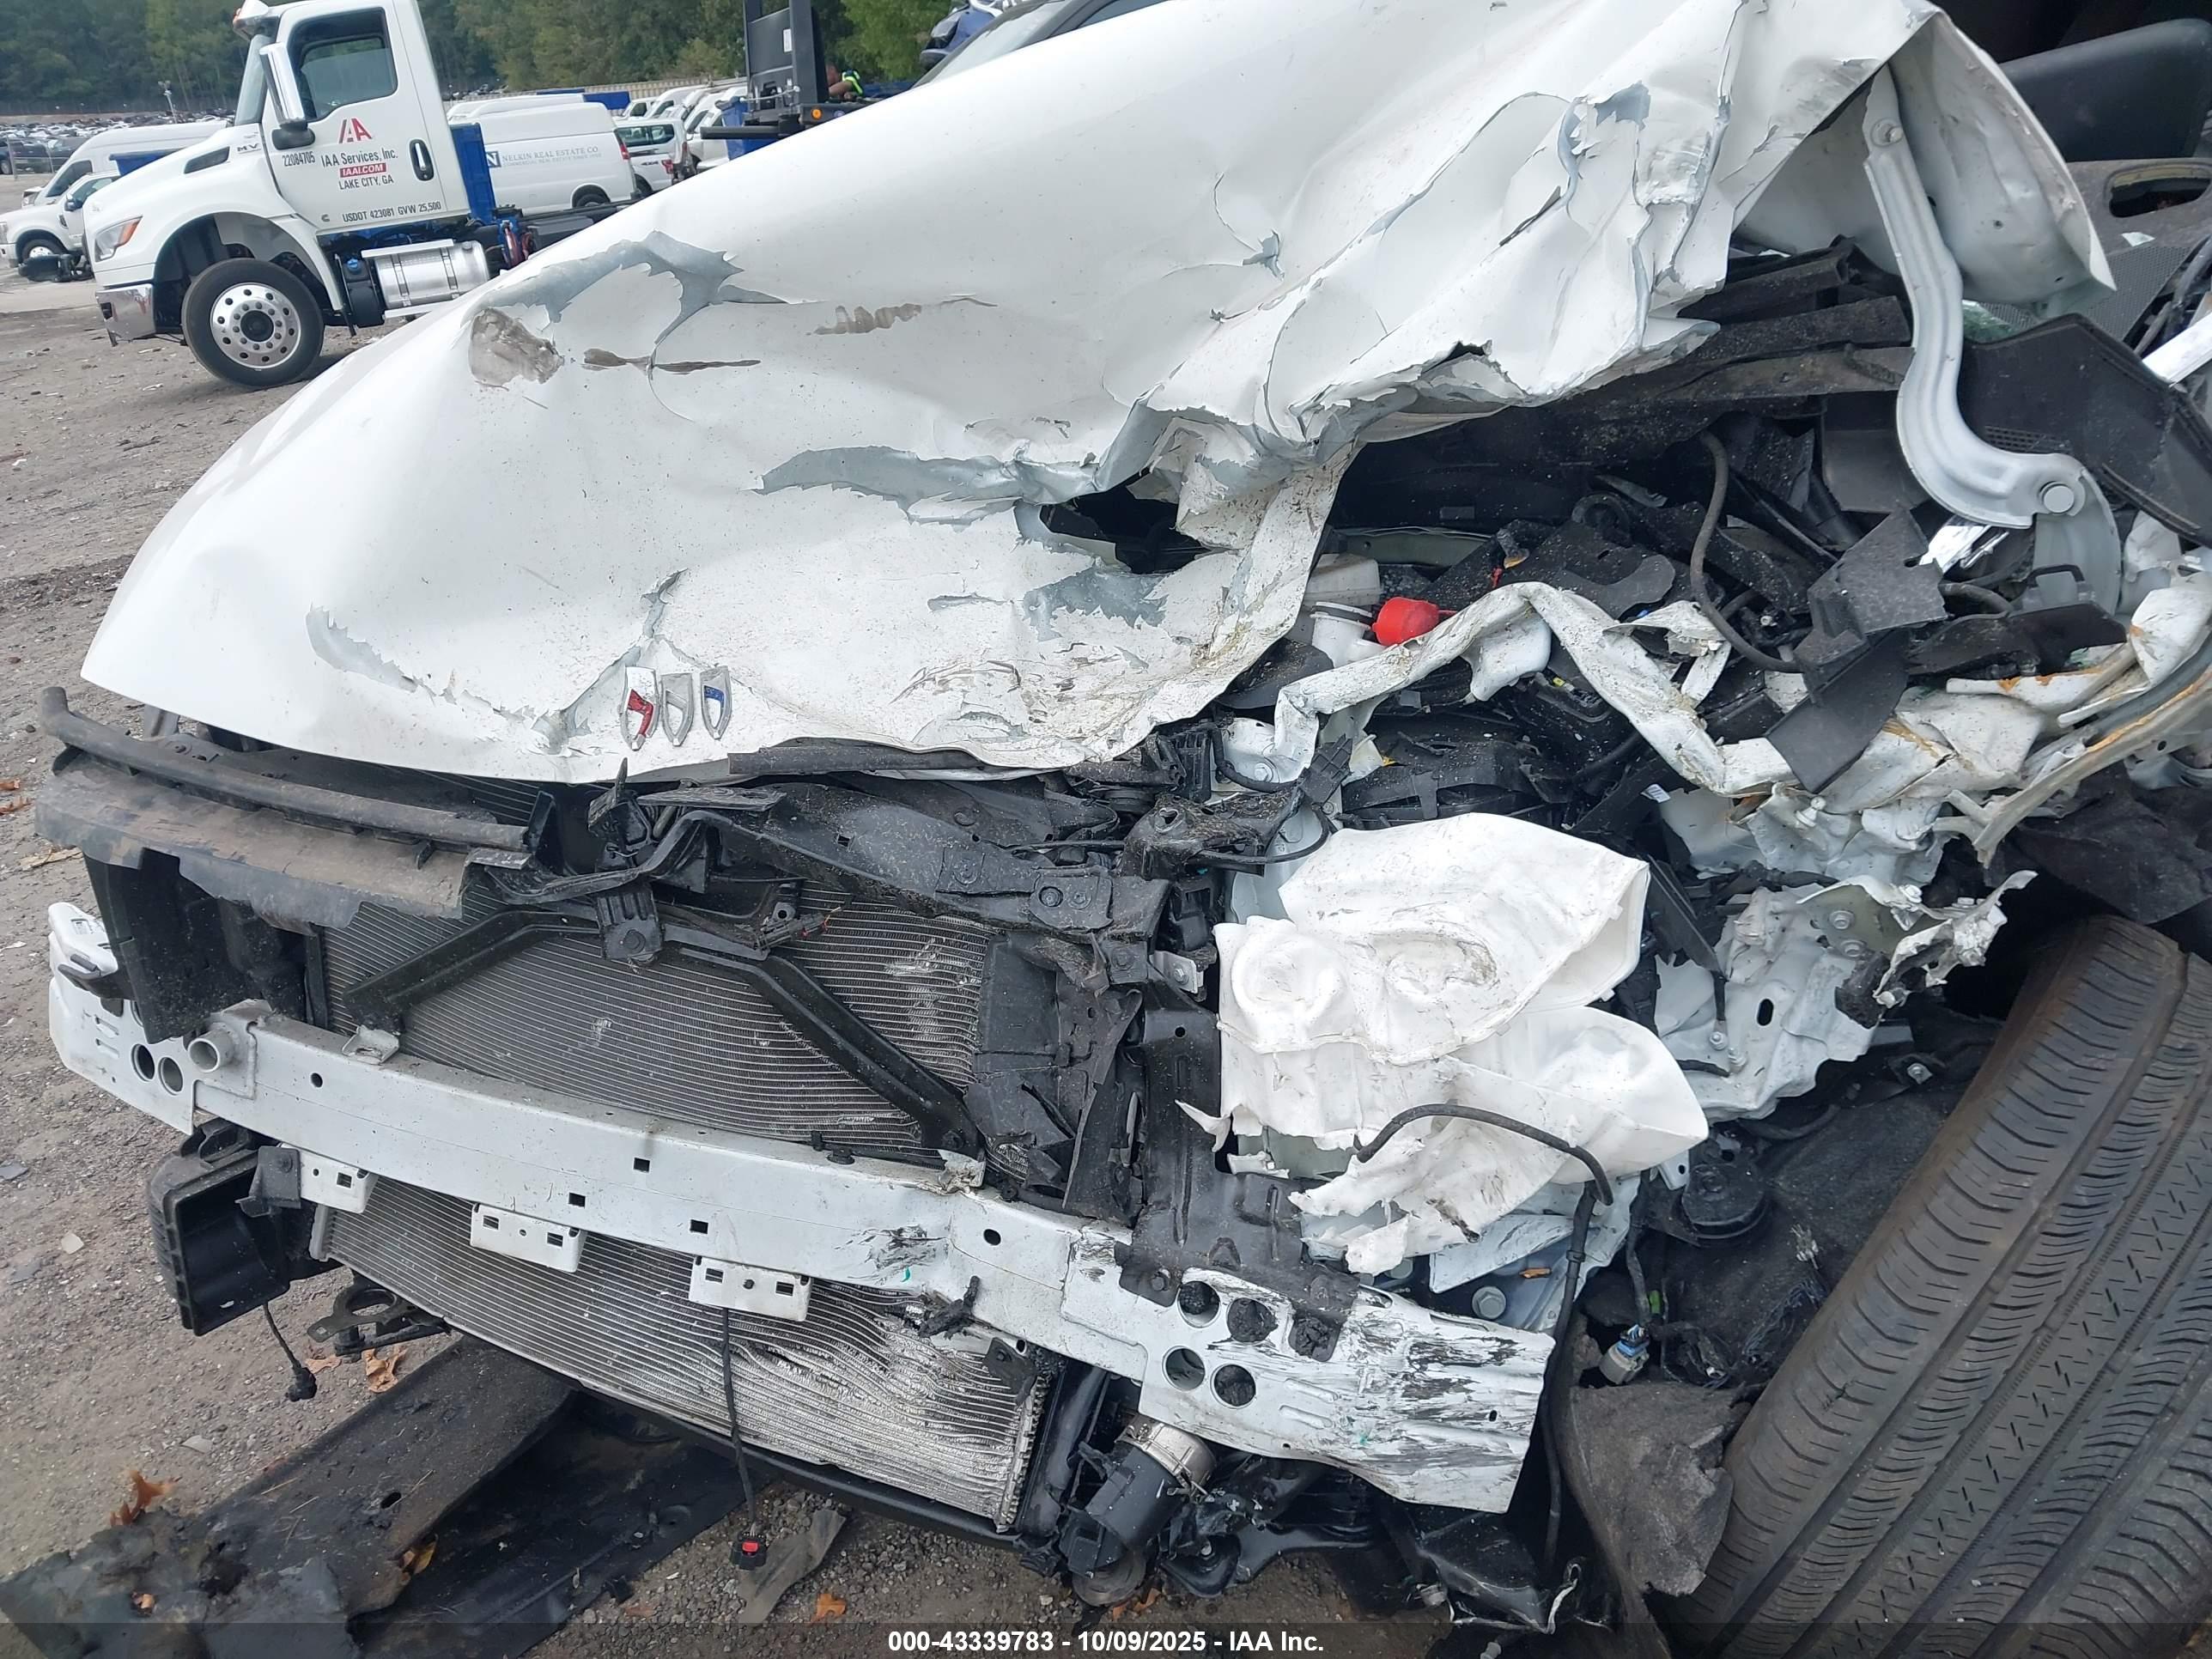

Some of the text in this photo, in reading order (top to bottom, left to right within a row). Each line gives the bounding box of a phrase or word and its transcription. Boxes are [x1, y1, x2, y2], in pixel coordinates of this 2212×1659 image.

[283, 151, 315, 167] 22084705
[320, 147, 398, 168] IAA Services, Inc.
[502, 151, 532, 161] NELKIN
[534, 149, 554, 159] REAL
[556, 148, 586, 157] ESTATE
[342, 164, 384, 176] IAAI.COM
[338, 174, 394, 190] LAKE CITY, GA
[343, 201, 441, 222] USDOT 423081 GVW 25,500
